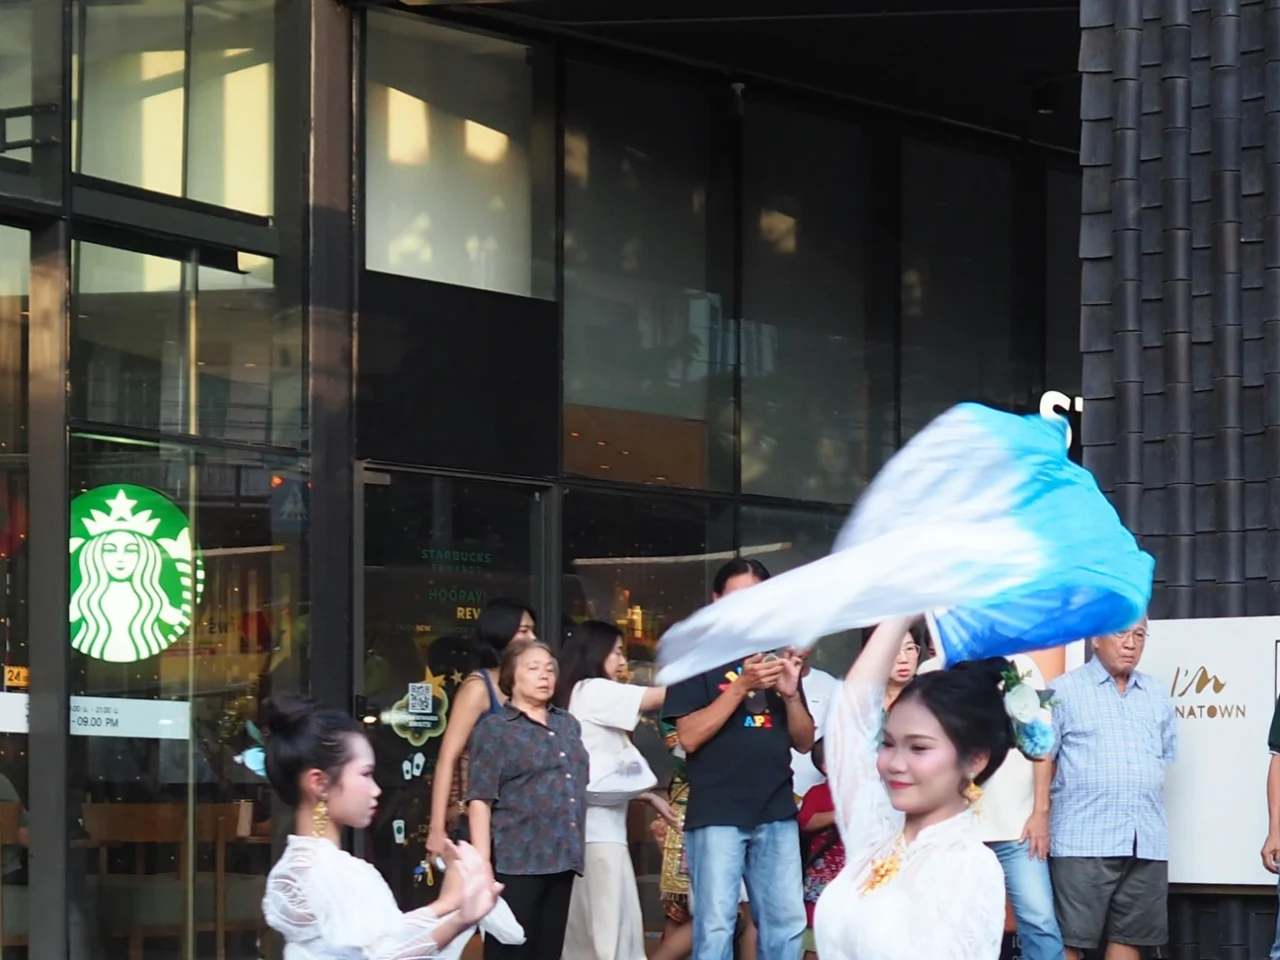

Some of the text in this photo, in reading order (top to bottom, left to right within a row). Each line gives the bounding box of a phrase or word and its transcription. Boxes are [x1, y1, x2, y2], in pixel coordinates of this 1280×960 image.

[420, 549, 492, 563] STARBUCKS
[7, 669, 21, 682] 24
[77, 714, 103, 727] 09.00
[105, 716, 119, 728] PM
